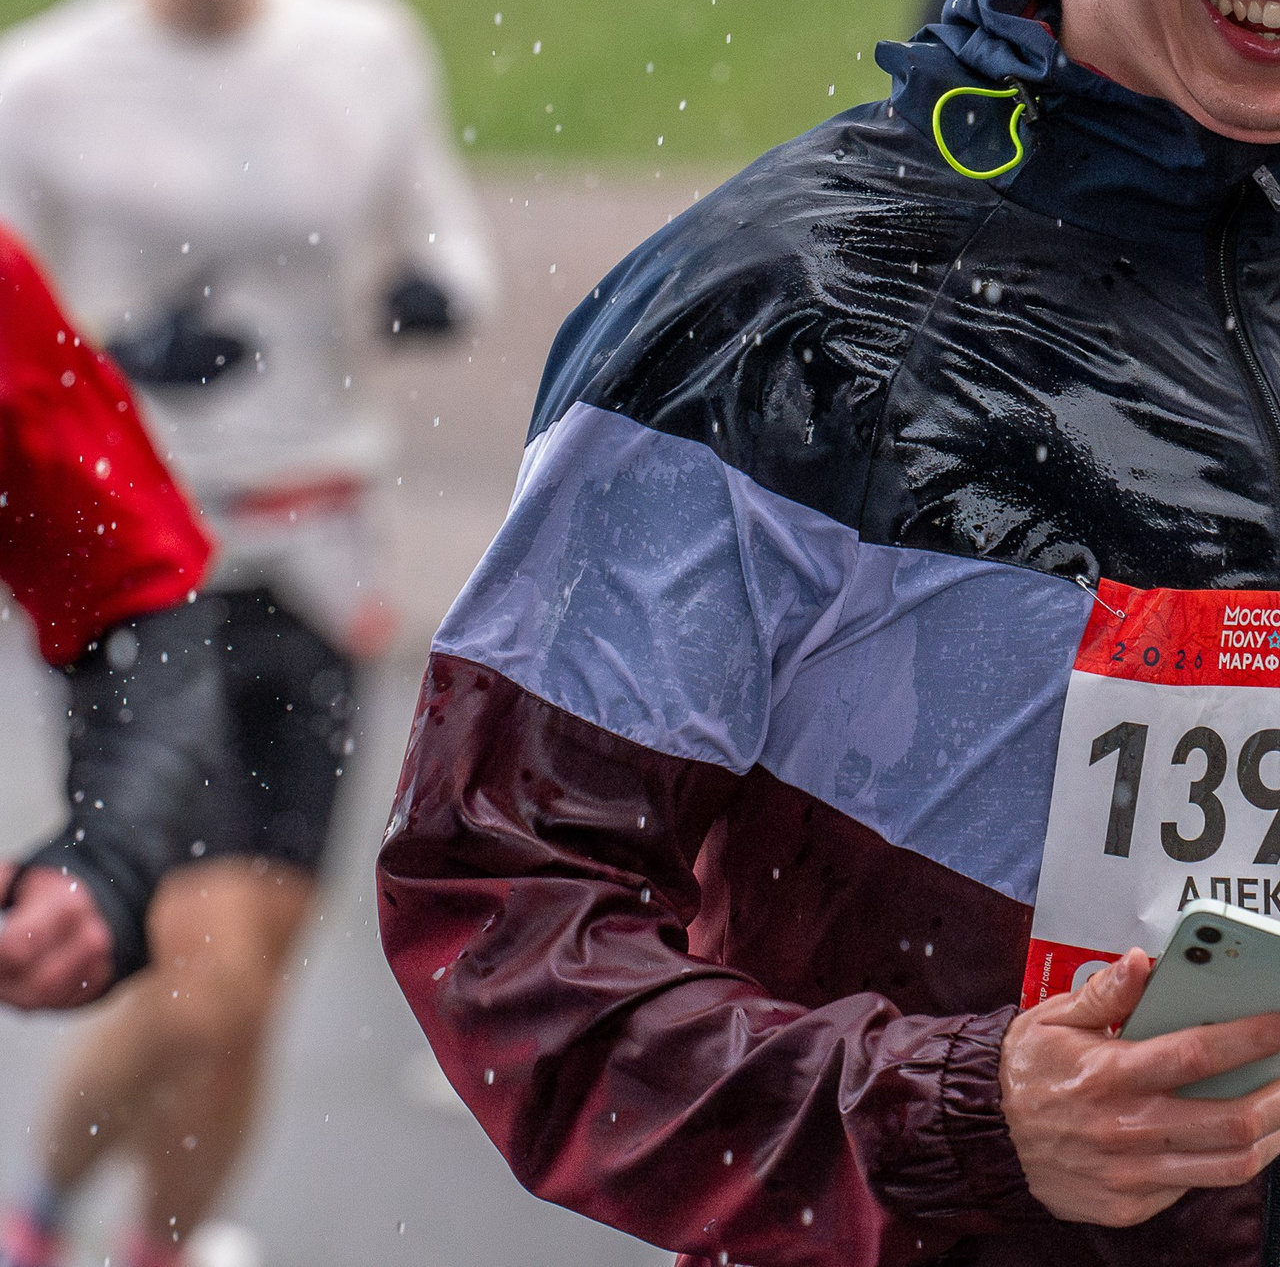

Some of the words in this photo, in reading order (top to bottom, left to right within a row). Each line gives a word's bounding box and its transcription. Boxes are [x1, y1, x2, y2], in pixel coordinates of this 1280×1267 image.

[1220, 630, 1267, 648] ПОЛУ
[1111, 642, 1203, 670] 2026
[1042, 952, 1054, 982] CORRAL
